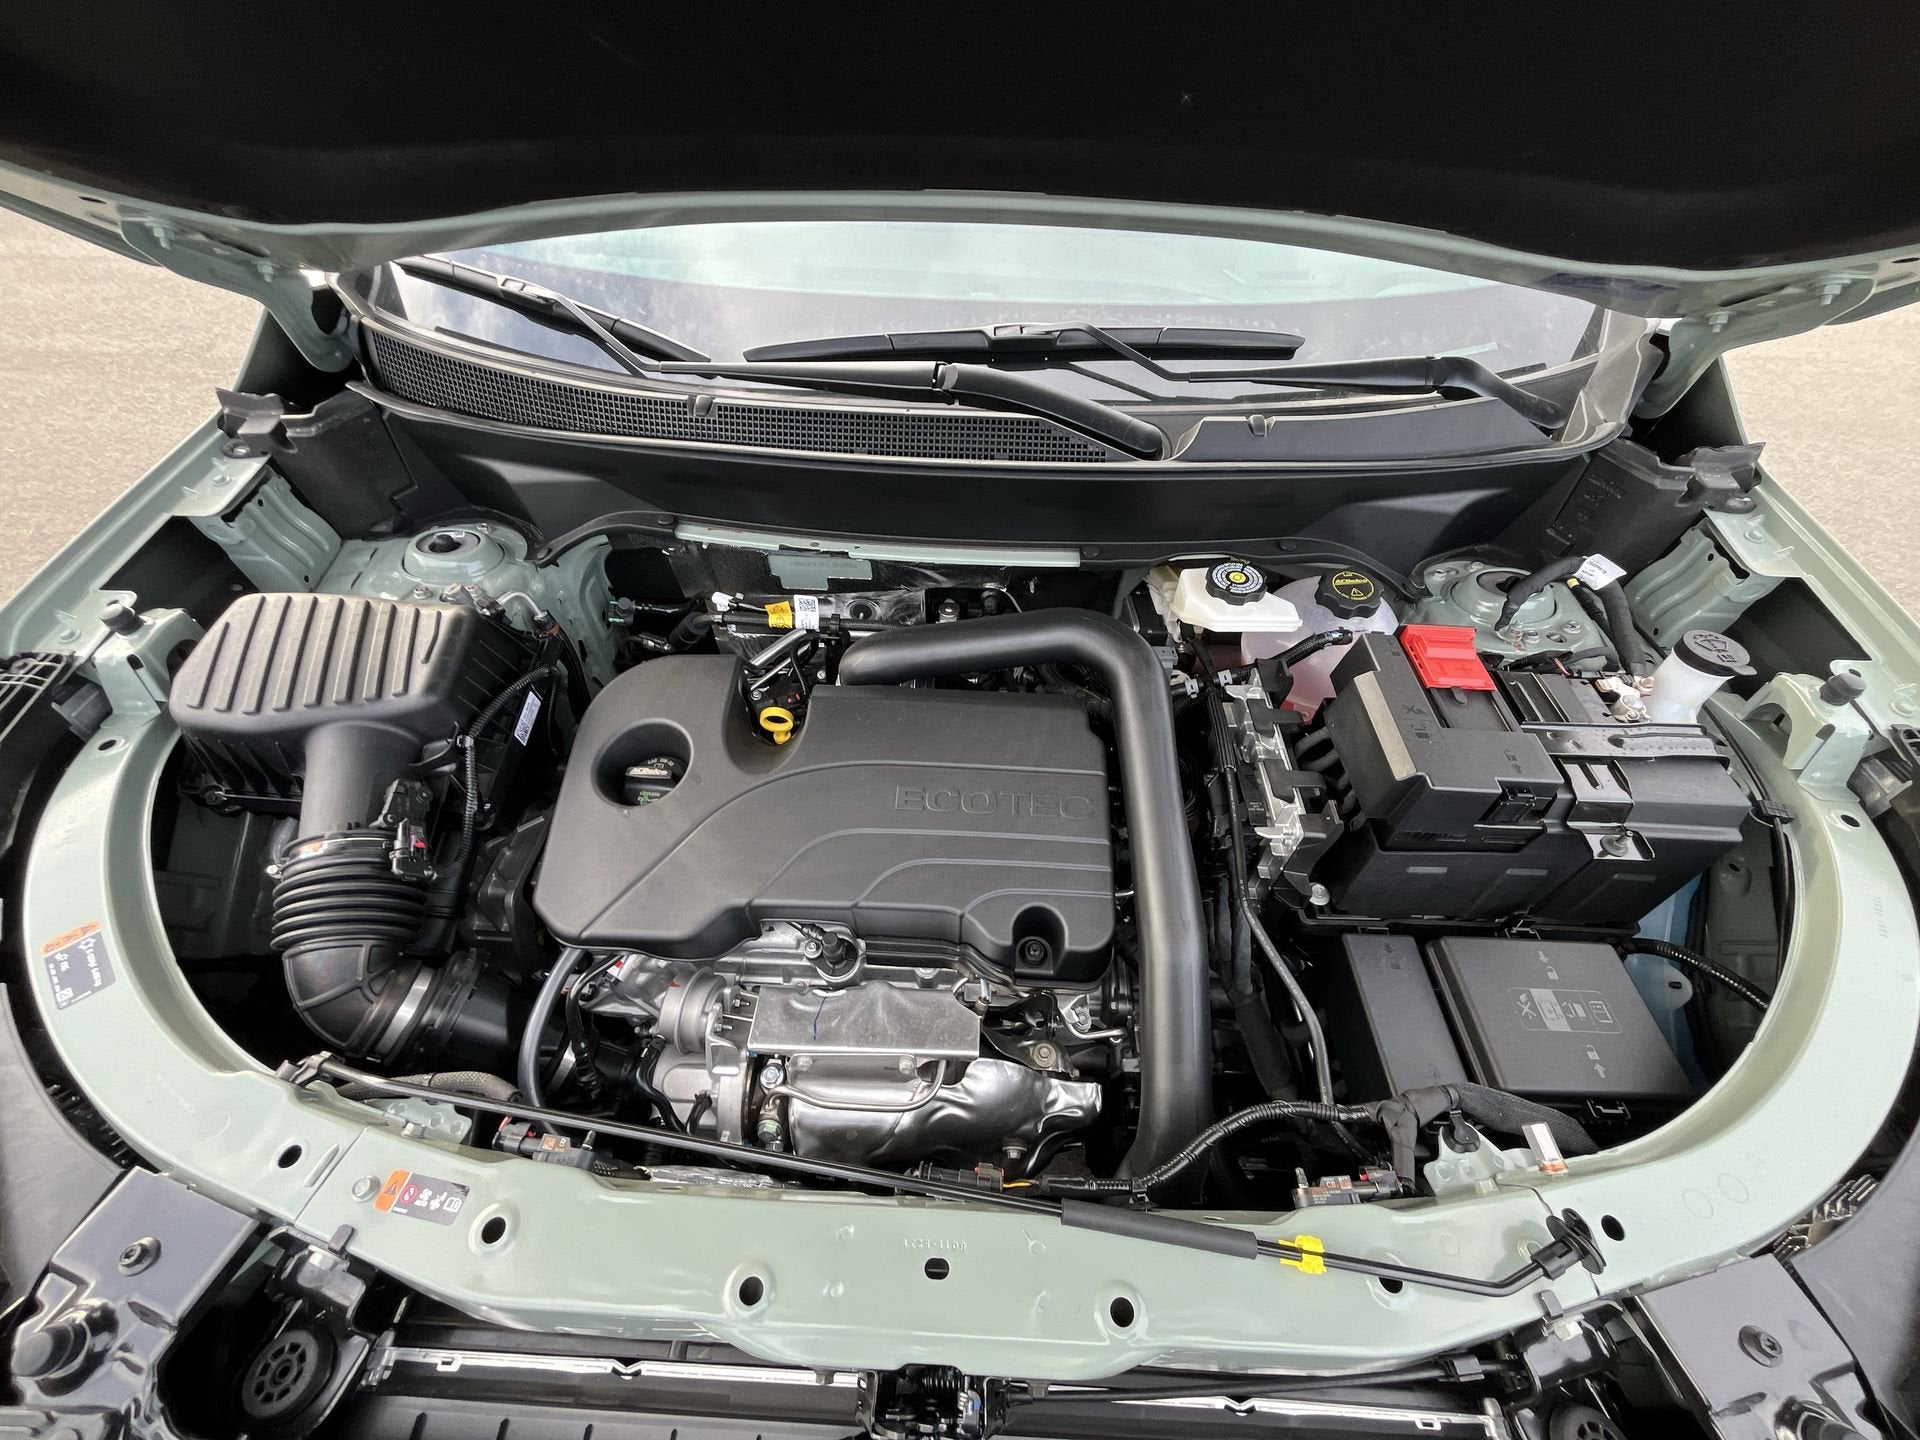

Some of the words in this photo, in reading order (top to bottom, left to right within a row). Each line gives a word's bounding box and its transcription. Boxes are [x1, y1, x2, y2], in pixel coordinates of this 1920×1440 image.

[1334, 578, 1369, 586] ACDelco
[629, 767, 668, 776] ACDelco
[894, 784, 1096, 820] ECOTEC
